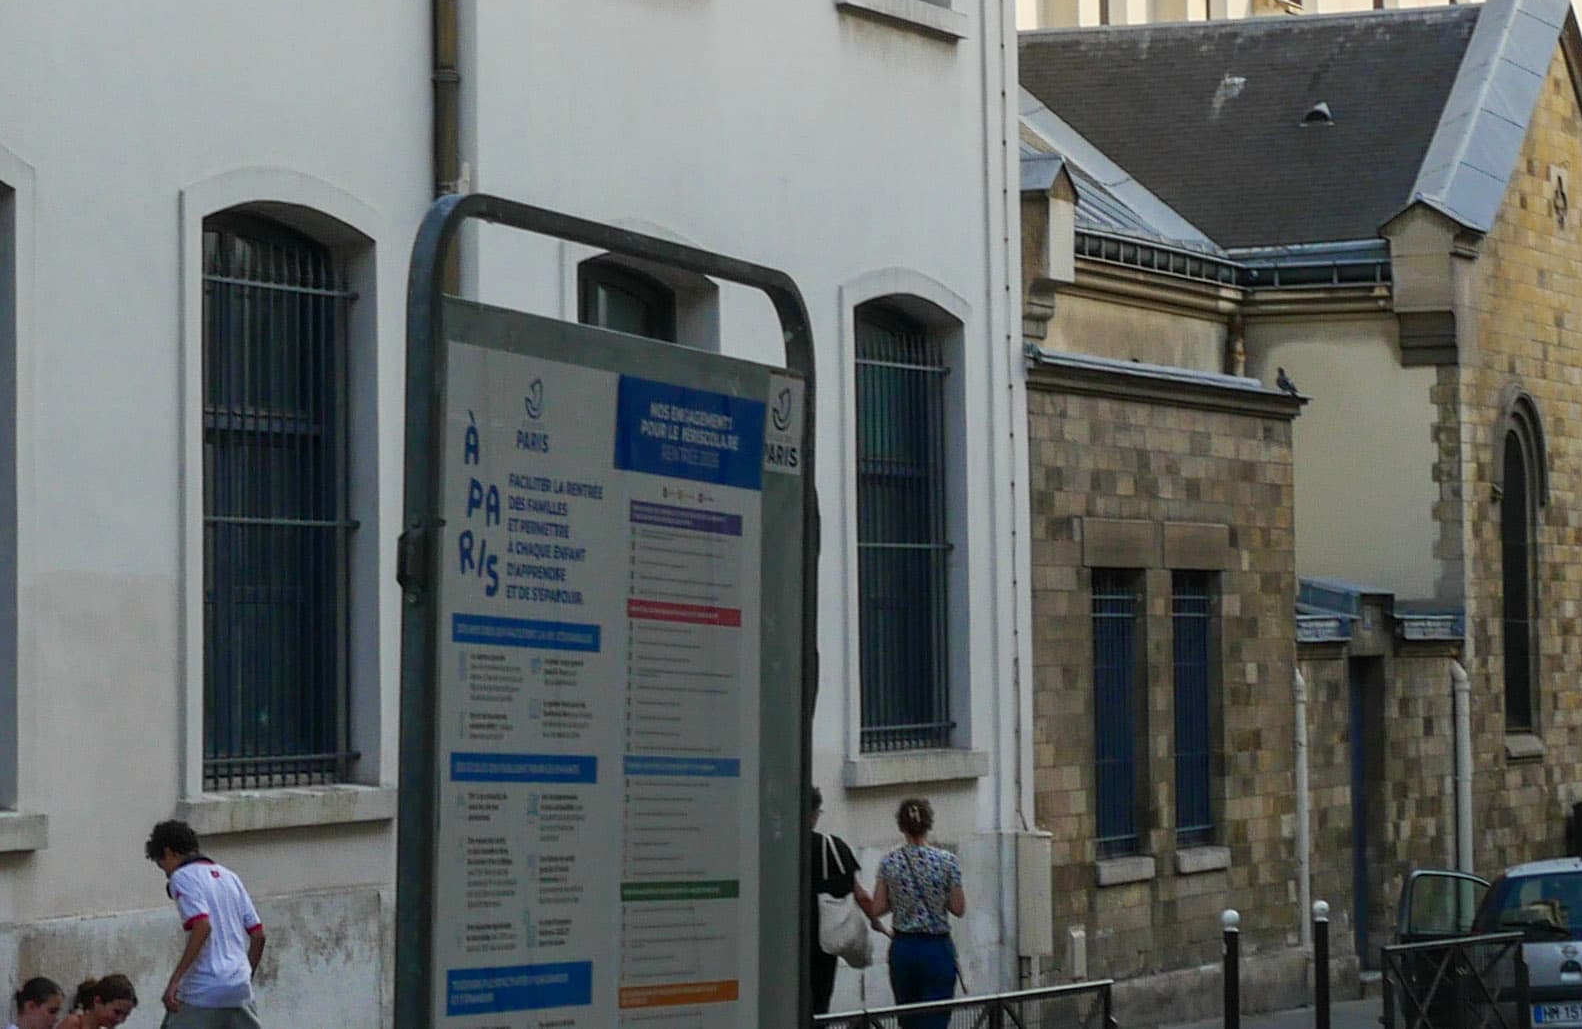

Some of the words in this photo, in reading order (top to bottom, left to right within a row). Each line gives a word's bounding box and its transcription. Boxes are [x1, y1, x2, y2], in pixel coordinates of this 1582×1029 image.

[464, 409, 479, 465] À
[640, 418, 666, 439] POUR
[667, 424, 679, 441] LE
[516, 429, 550, 454] PARIS
[766, 443, 798, 467] ARIS
[508, 473, 552, 493] FACILITER
[553, 478, 564, 494] LA
[508, 495, 525, 511] DES
[527, 498, 568, 516] FAMILLES
[508, 517, 518, 532] ET
[520, 518, 570, 539] PERMETTRE
[515, 541, 552, 560] CHAQUE
[553, 545, 586, 562] ENFANT
[506, 584, 517, 599] ET
[518, 585, 531, 600] DE
